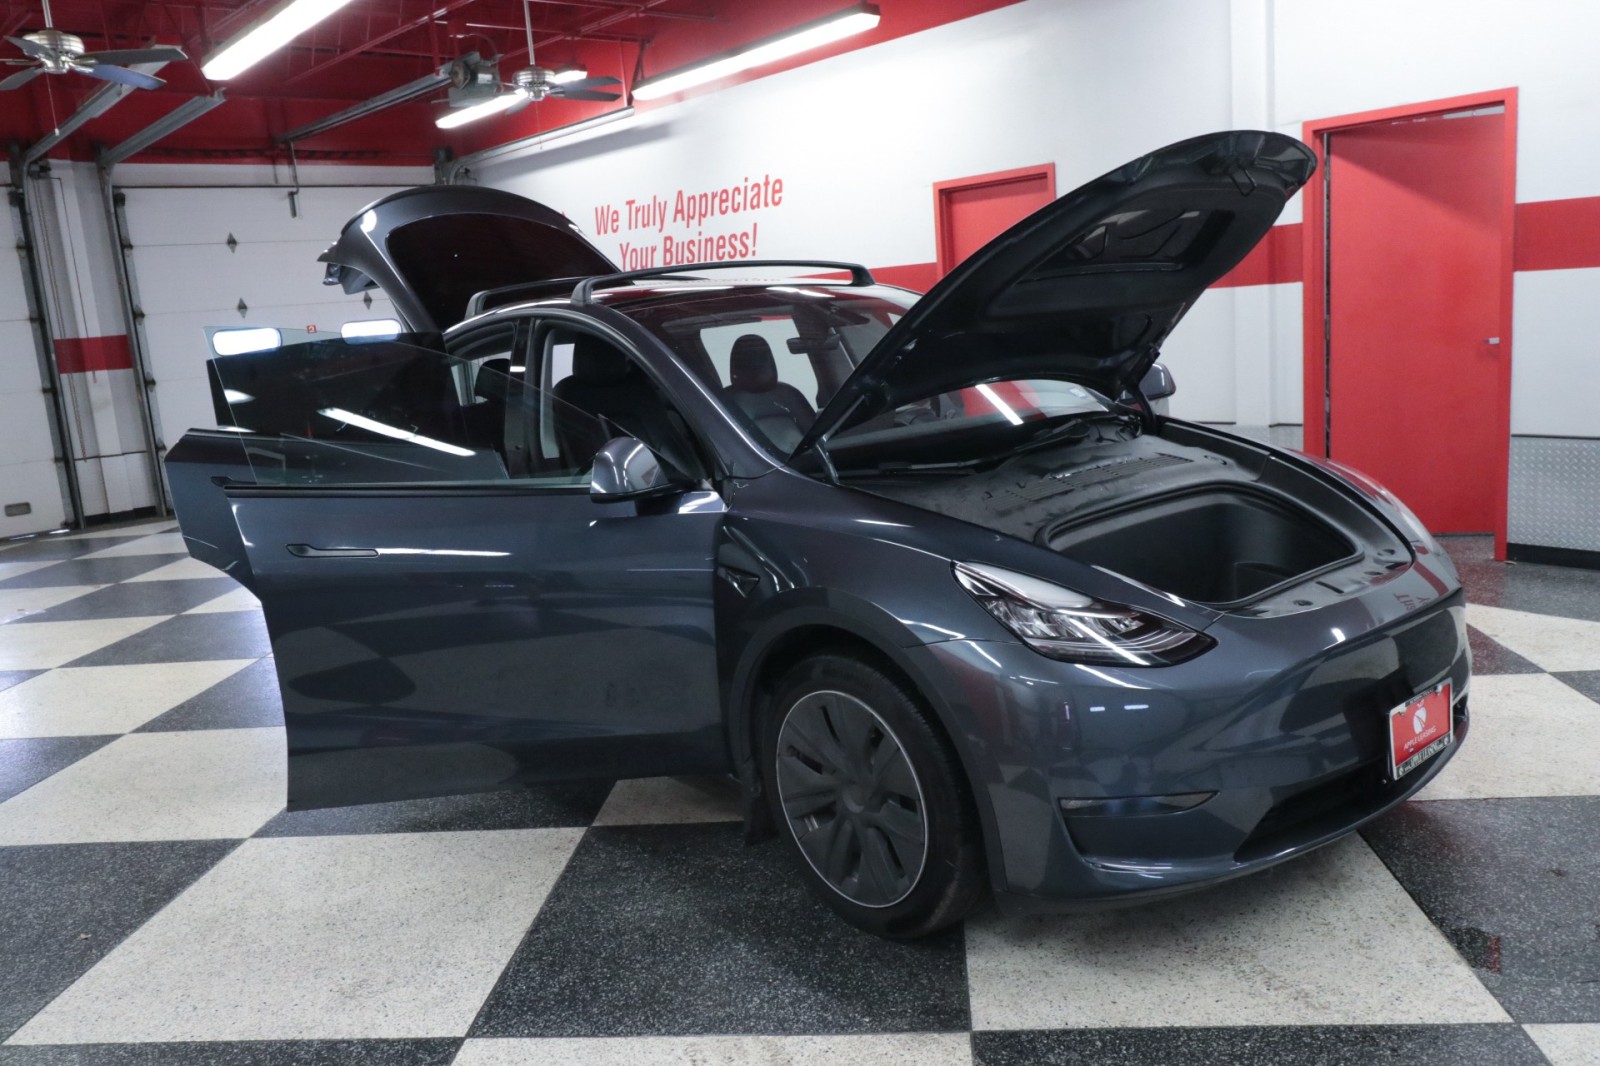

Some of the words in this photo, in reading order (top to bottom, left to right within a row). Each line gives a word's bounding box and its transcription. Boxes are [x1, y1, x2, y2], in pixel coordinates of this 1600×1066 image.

[595, 204, 619, 235] We
[626, 195, 667, 233] Truly
[673, 174, 783, 228] Appreciate
[619, 242, 657, 272] Your
[663, 222, 758, 266] Business!
